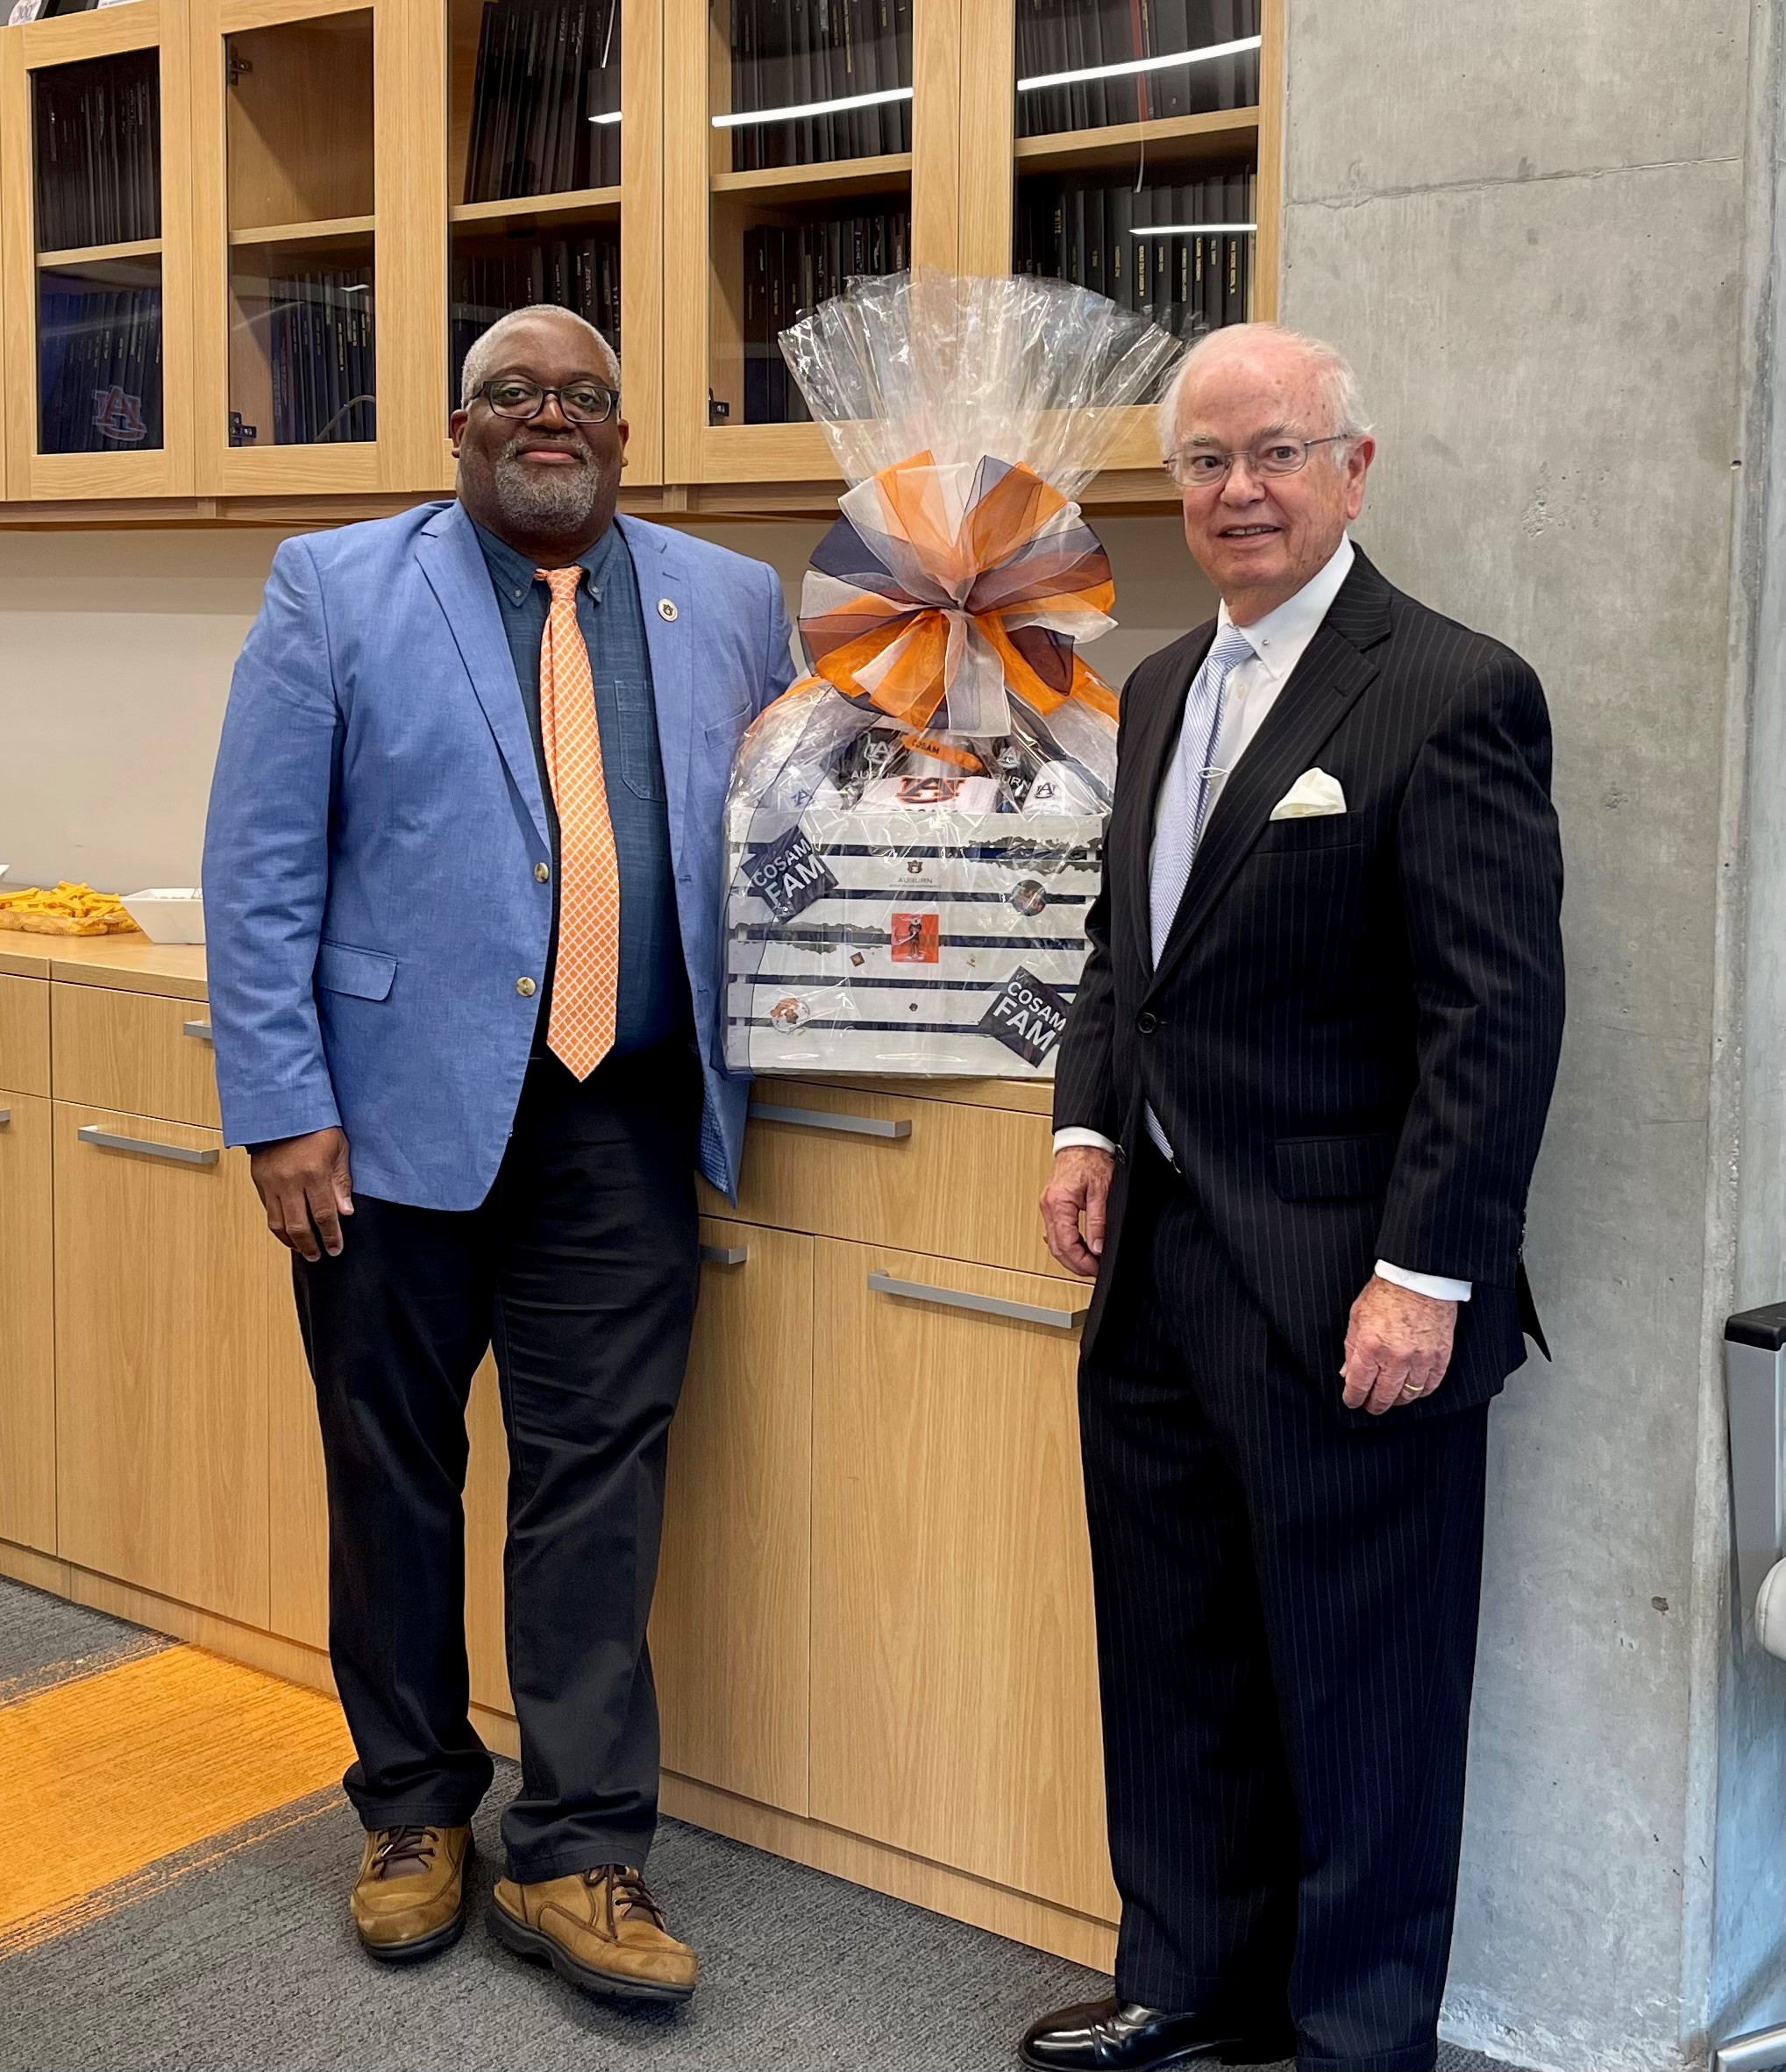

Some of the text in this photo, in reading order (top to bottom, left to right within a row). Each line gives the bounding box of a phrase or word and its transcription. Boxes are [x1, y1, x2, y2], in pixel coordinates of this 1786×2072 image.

[753, 838, 811, 887] COSAM
[765, 854, 826, 907] FAM
[993, 995, 1057, 1052] FAM
[1007, 981, 1067, 1032] COSAM
